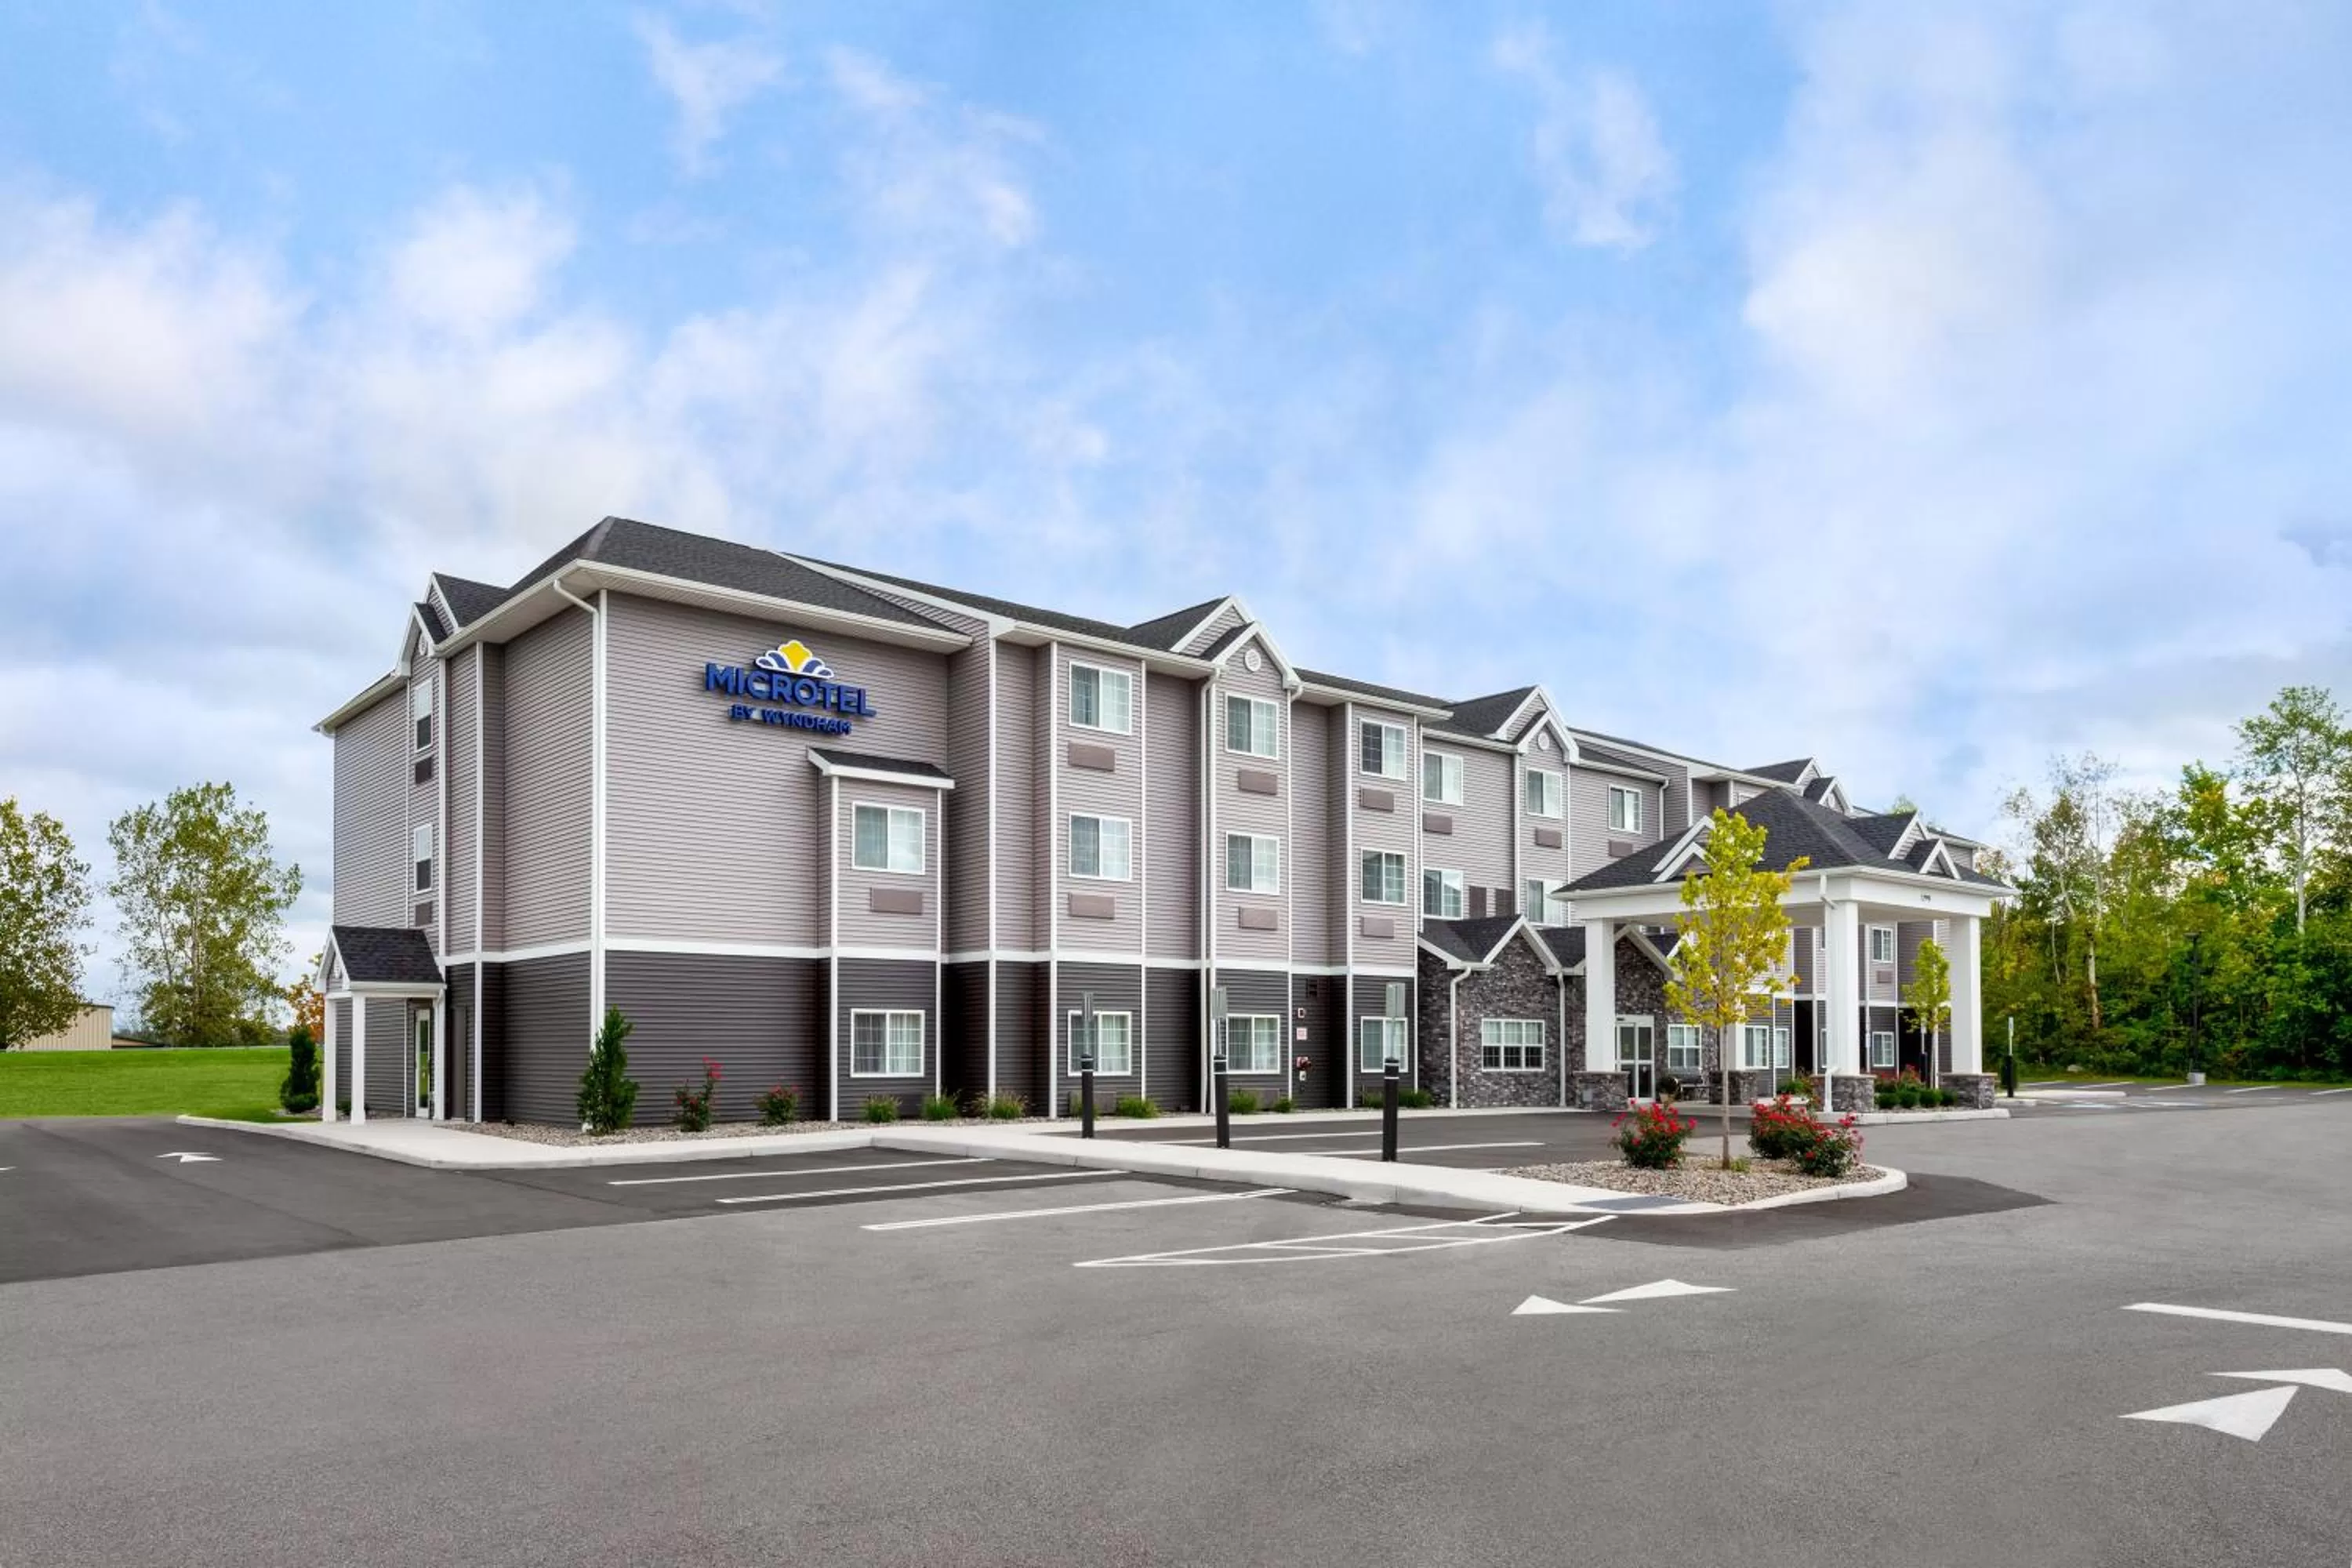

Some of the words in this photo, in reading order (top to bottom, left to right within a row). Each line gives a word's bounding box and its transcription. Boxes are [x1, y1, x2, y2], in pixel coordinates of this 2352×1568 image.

[706, 662, 877, 716] MICROTEL
[730, 703, 754, 720] BY
[762, 708, 851, 735] WYNDHAM
